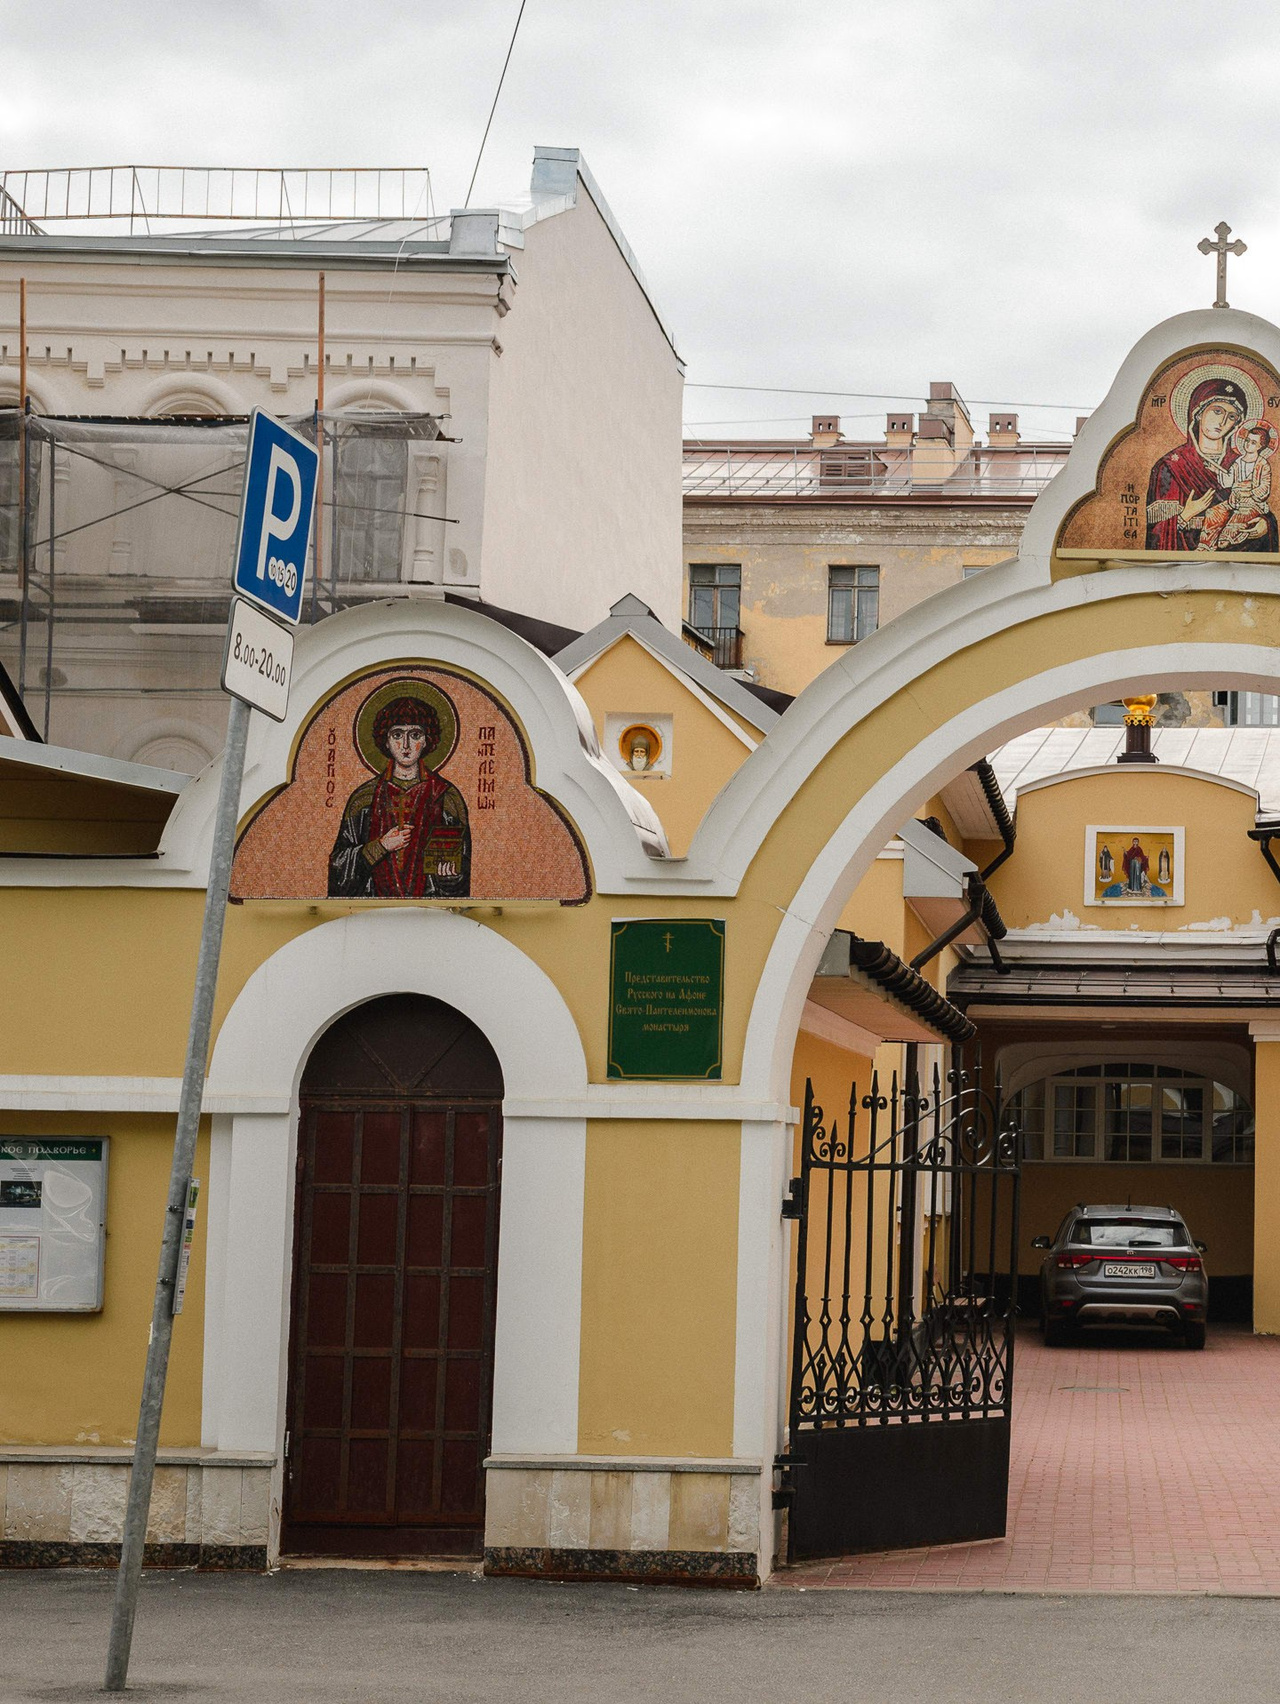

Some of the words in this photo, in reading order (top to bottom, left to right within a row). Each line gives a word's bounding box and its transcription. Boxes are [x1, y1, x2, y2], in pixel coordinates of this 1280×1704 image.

[256, 442, 302, 580] P
[285, 569, 296, 592] 20
[233, 632, 286, 687] 8.00-20.00
[625, 971, 710, 985] Представительство
[627, 988, 664, 1002] Русского
[666, 991, 676, 999] на
[679, 988, 707, 1002] Афоне
[641, 1023, 690, 1034] монастыря
[28, 1145, 87, 1154] ПОДВОРЬЕ
